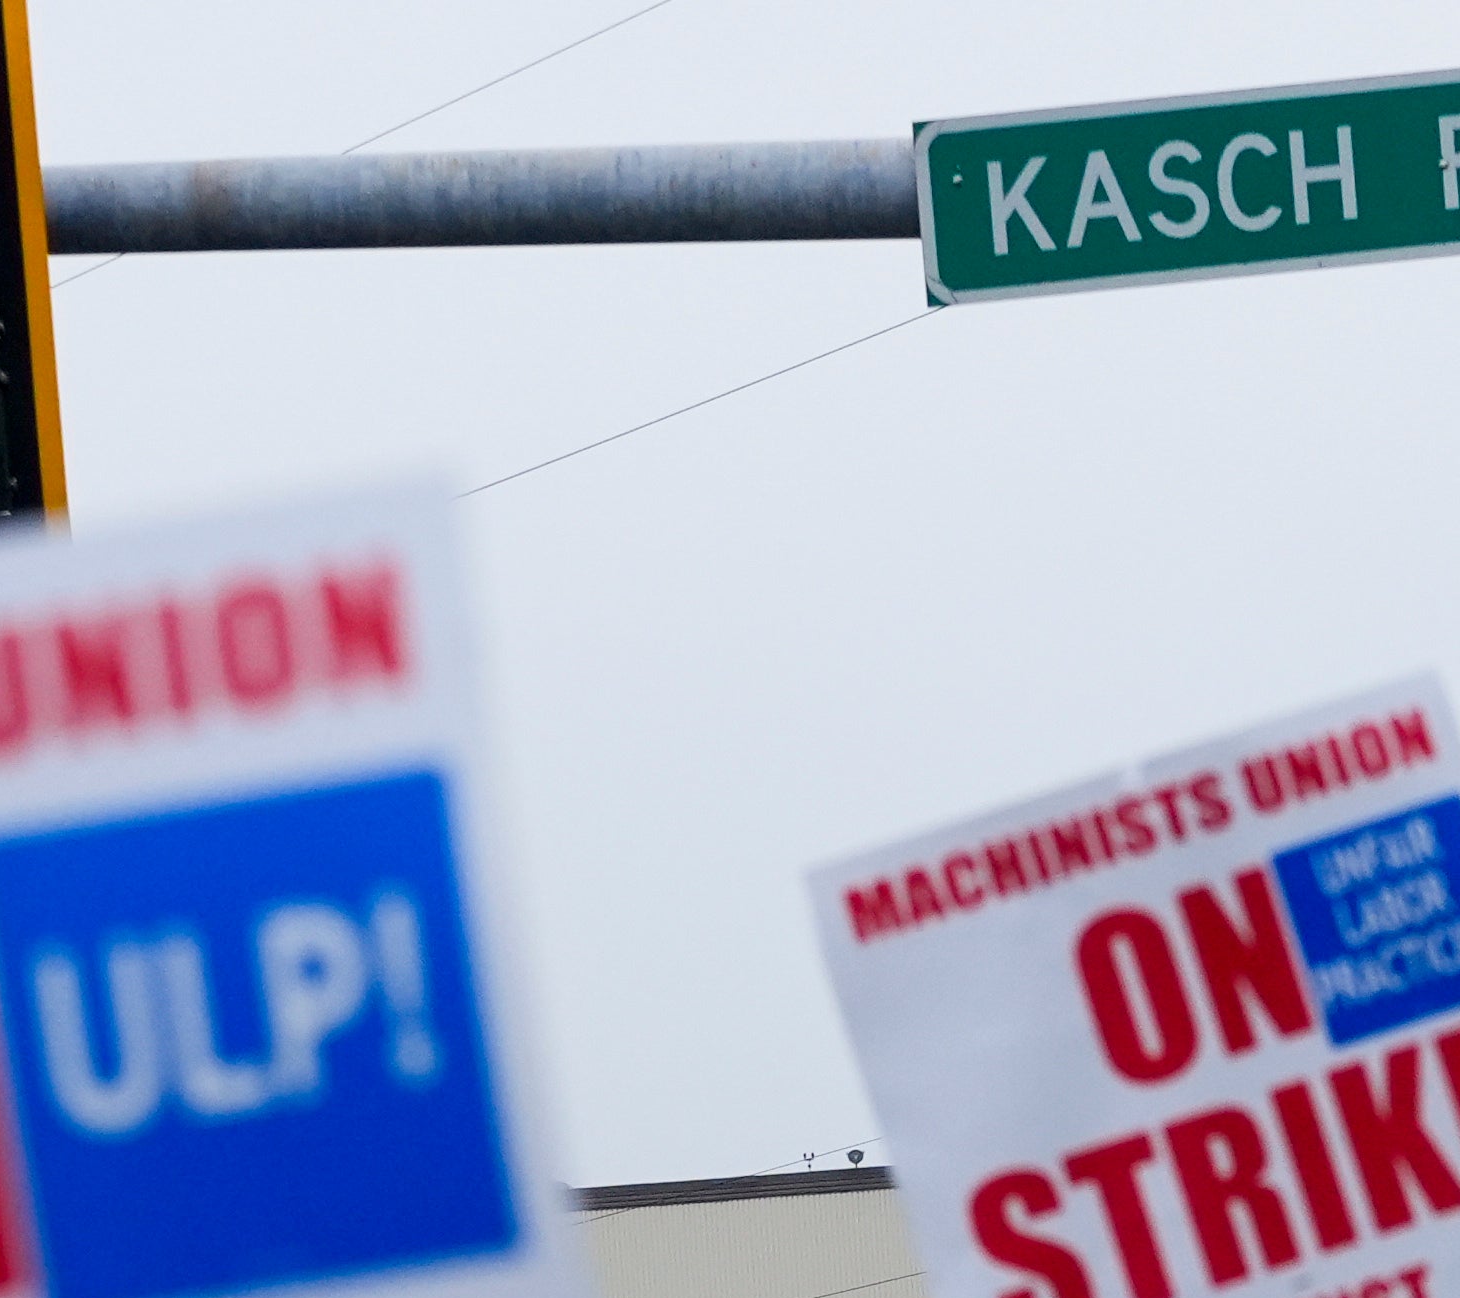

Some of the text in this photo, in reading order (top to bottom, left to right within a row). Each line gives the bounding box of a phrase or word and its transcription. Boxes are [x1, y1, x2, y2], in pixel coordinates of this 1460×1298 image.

[988, 125, 1358, 256] KASCH
[842, 705, 1439, 946] MACHINISTS UNION
[30, 880, 445, 1140] ULP!
[1071, 862, 1315, 1086] ON
